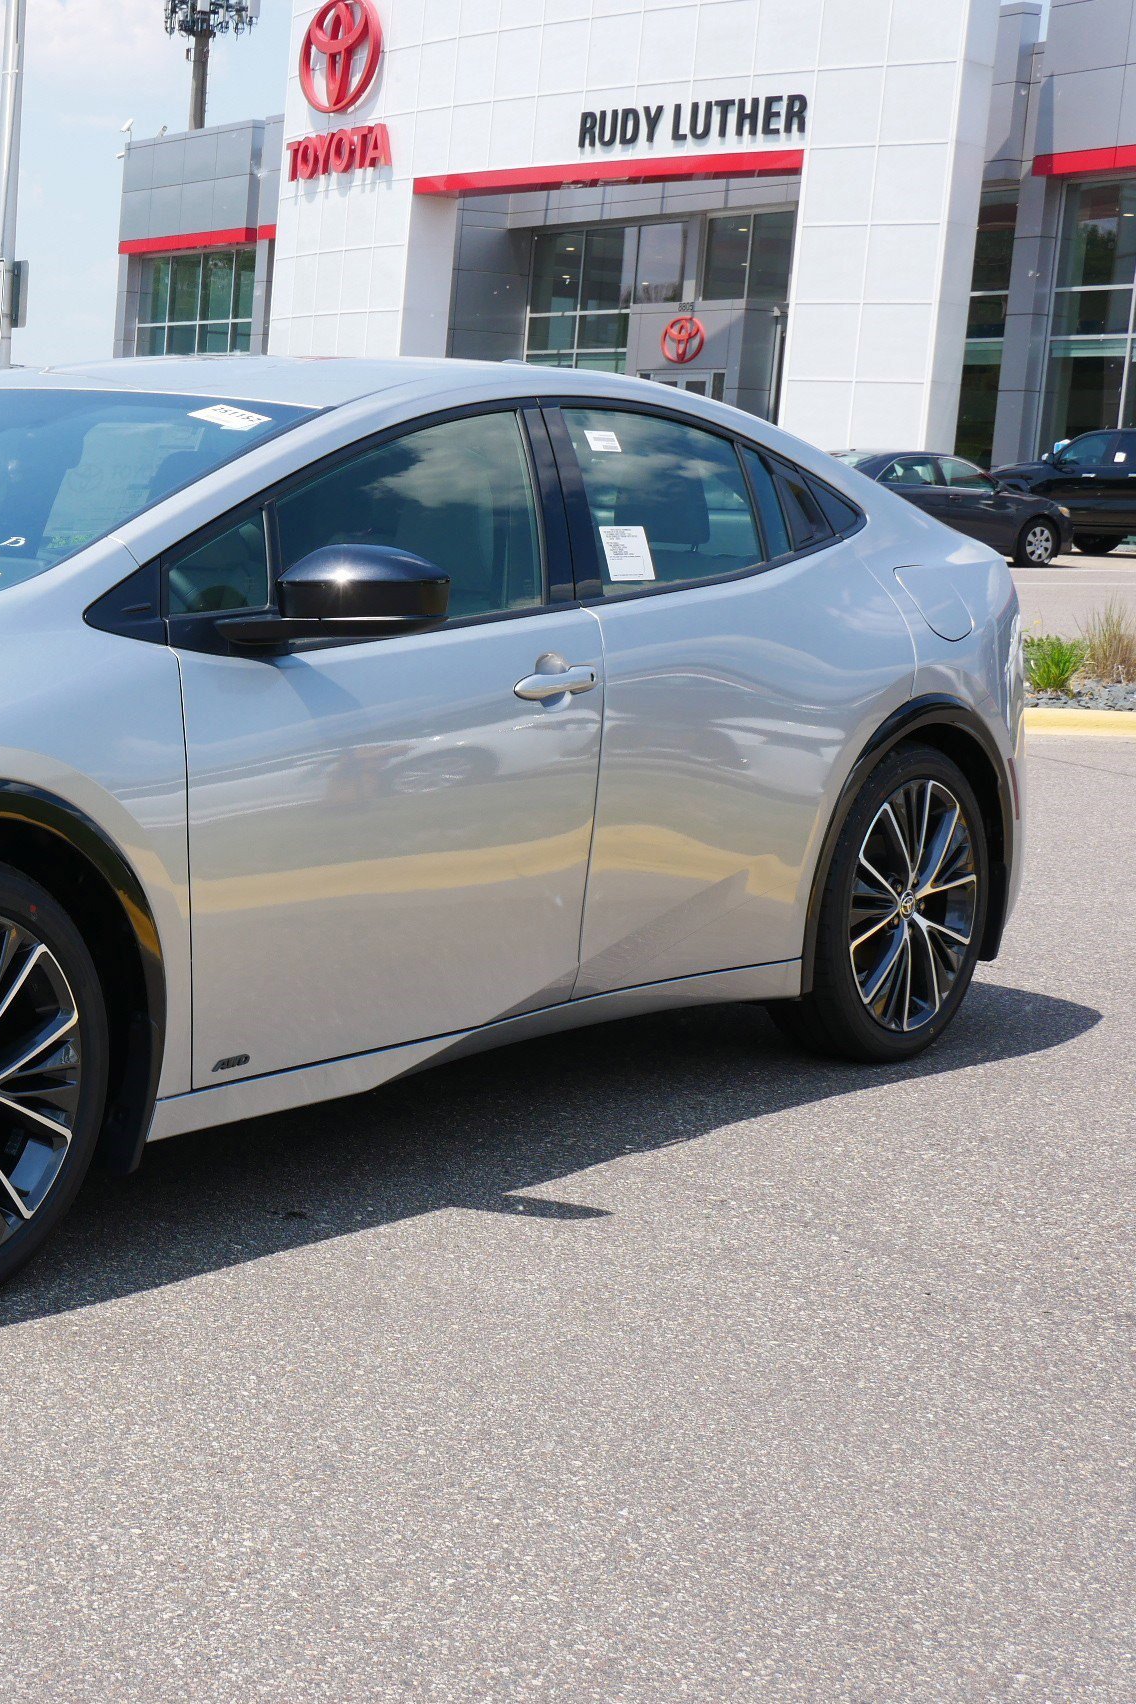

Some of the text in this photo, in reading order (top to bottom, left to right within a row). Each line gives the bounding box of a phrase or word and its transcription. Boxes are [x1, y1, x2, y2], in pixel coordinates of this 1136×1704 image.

[578, 94, 808, 148] RUDY LUTHER
[286, 123, 392, 182] TOYOTA
